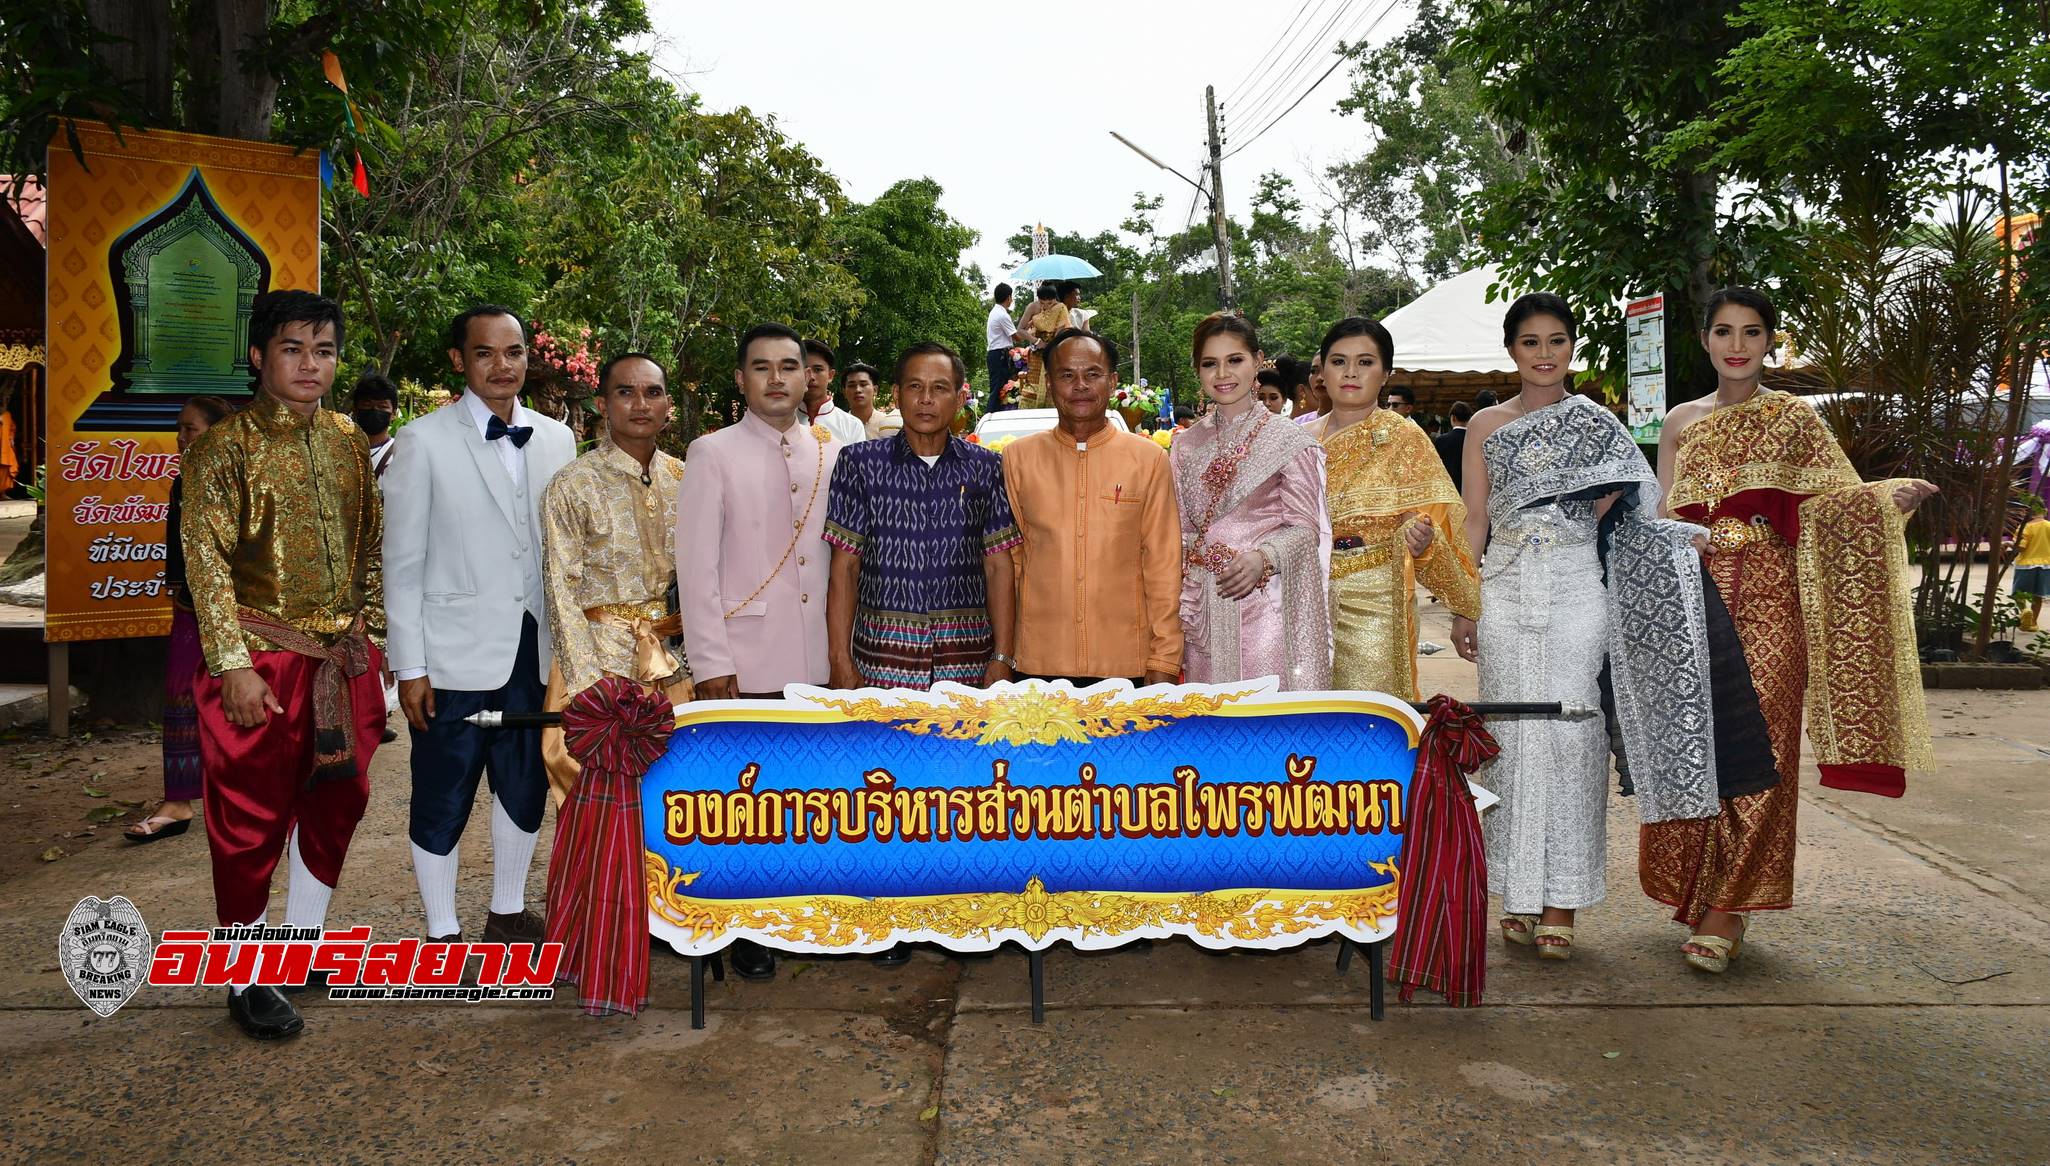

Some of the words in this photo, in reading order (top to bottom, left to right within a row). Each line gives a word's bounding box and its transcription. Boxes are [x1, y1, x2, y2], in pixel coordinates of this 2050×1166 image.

[664, 755, 1402, 844] องค์การบริหารส่วนตำบลไพรพัฒนา
